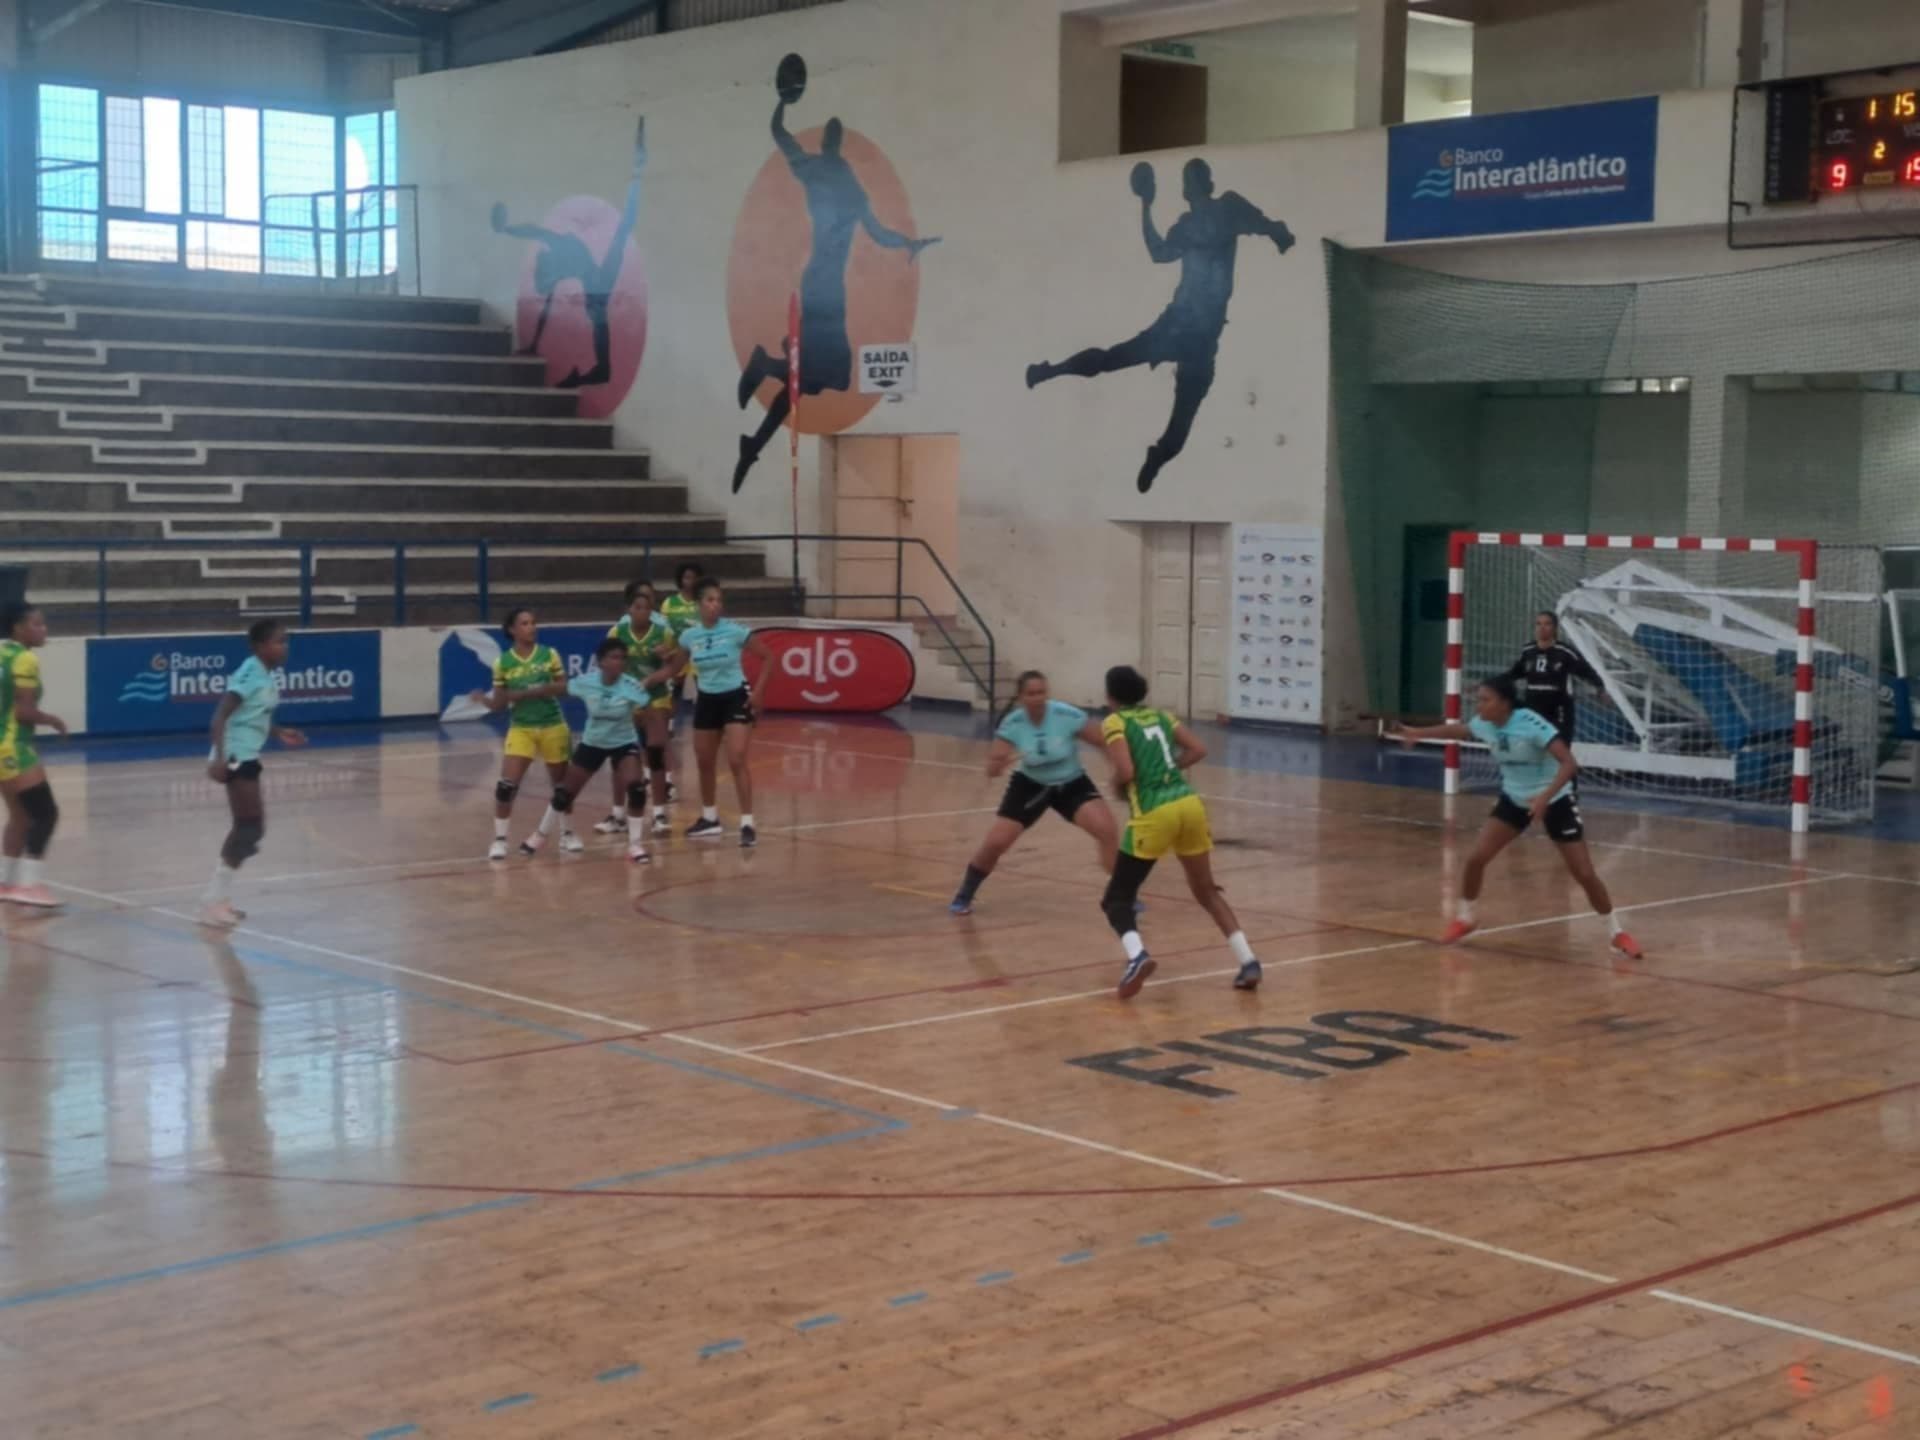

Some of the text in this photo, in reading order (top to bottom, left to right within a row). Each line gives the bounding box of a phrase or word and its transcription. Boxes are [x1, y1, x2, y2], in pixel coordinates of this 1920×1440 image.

[1455, 148, 1503, 165] Banco
[1873, 141, 1886, 159] 2
[1455, 154, 1626, 191] Interatlântico
[1832, 163, 1847, 187] 9
[863, 349, 910, 364] SAÍDA
[868, 366, 904, 378] EXIT
[170, 652, 225, 669] Banco
[1143, 726, 1175, 769] 7
[1064, 1009, 1519, 1098] FIBA
